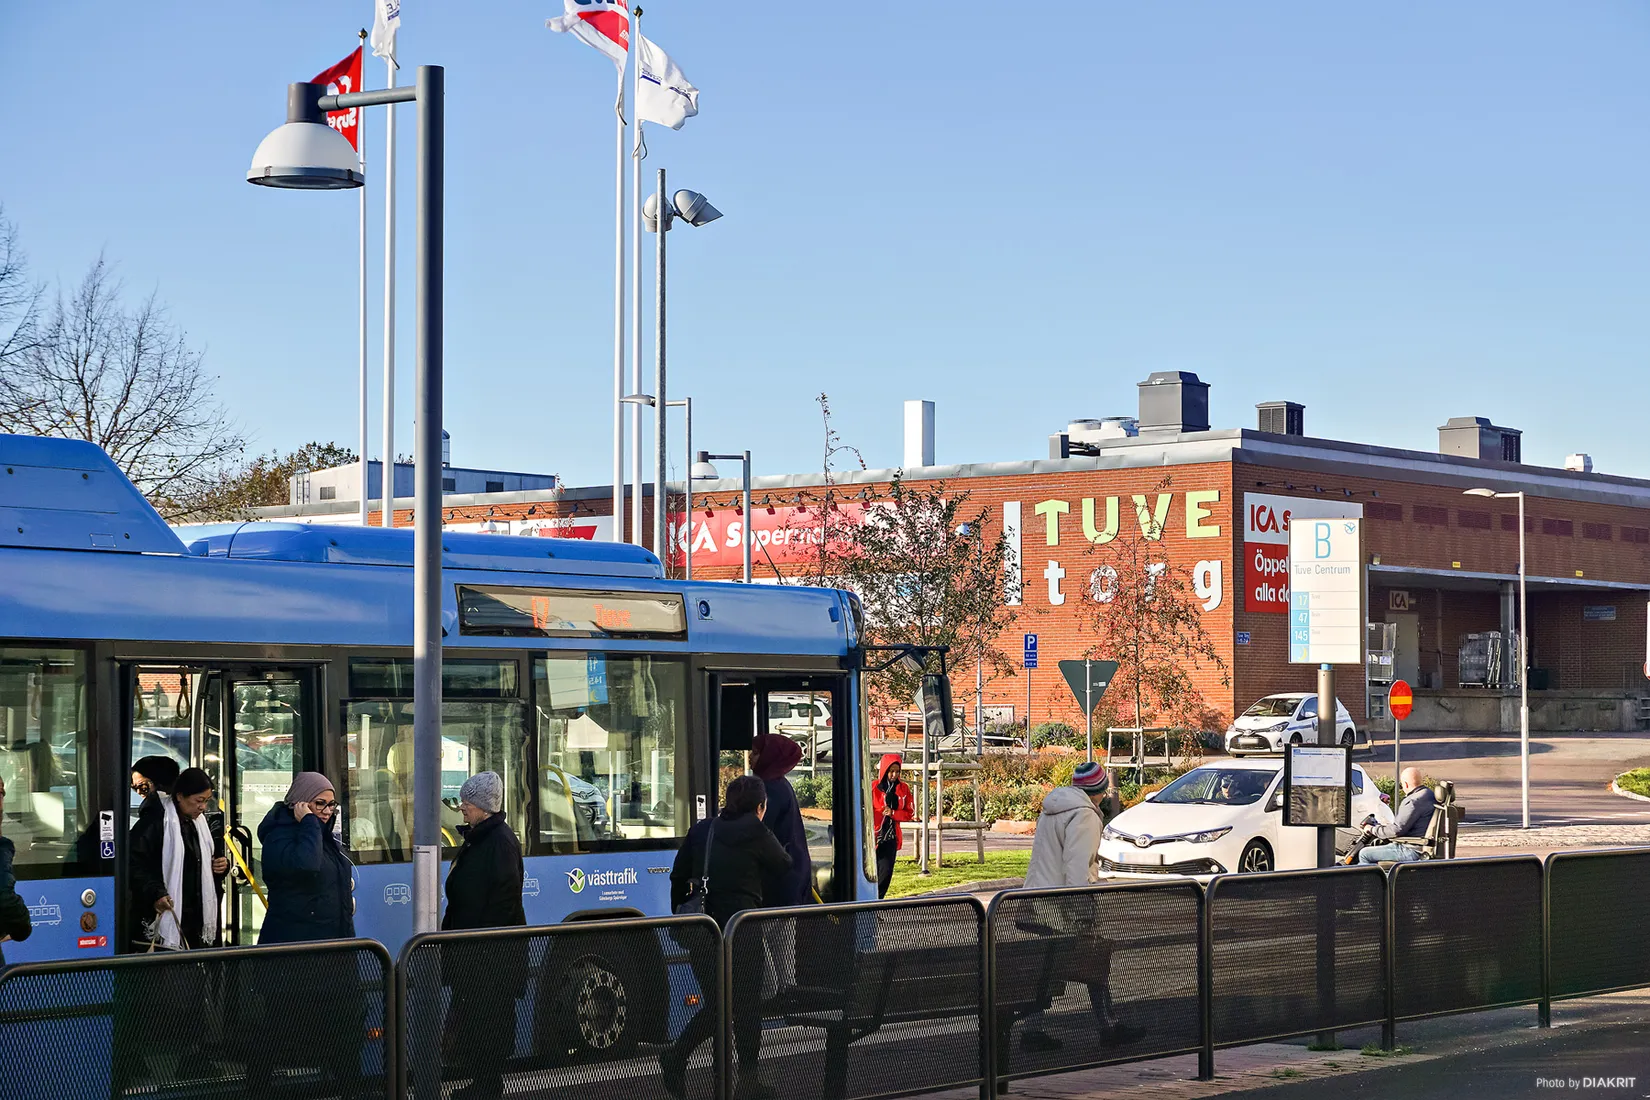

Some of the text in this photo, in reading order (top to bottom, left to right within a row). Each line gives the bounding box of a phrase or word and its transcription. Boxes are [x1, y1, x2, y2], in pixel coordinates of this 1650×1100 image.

[1034, 490, 1221, 546] TUVE
[1250, 504, 1280, 533] ICA
[669, 520, 719, 554] ICA
[1315, 522, 1331, 559] B
[1294, 564, 1351, 575] Tuve Centrum
[1044, 559, 1223, 612] torg
[1255, 582, 1276, 602] alla
[1298, 594, 1308, 606] 17
[1391, 591, 1407, 609] ICA
[1298, 612, 1308, 624] 47
[1027, 635, 1036, 650] P
[1294, 630, 1308, 642] 145
[587, 867, 638, 886] västtrafik
